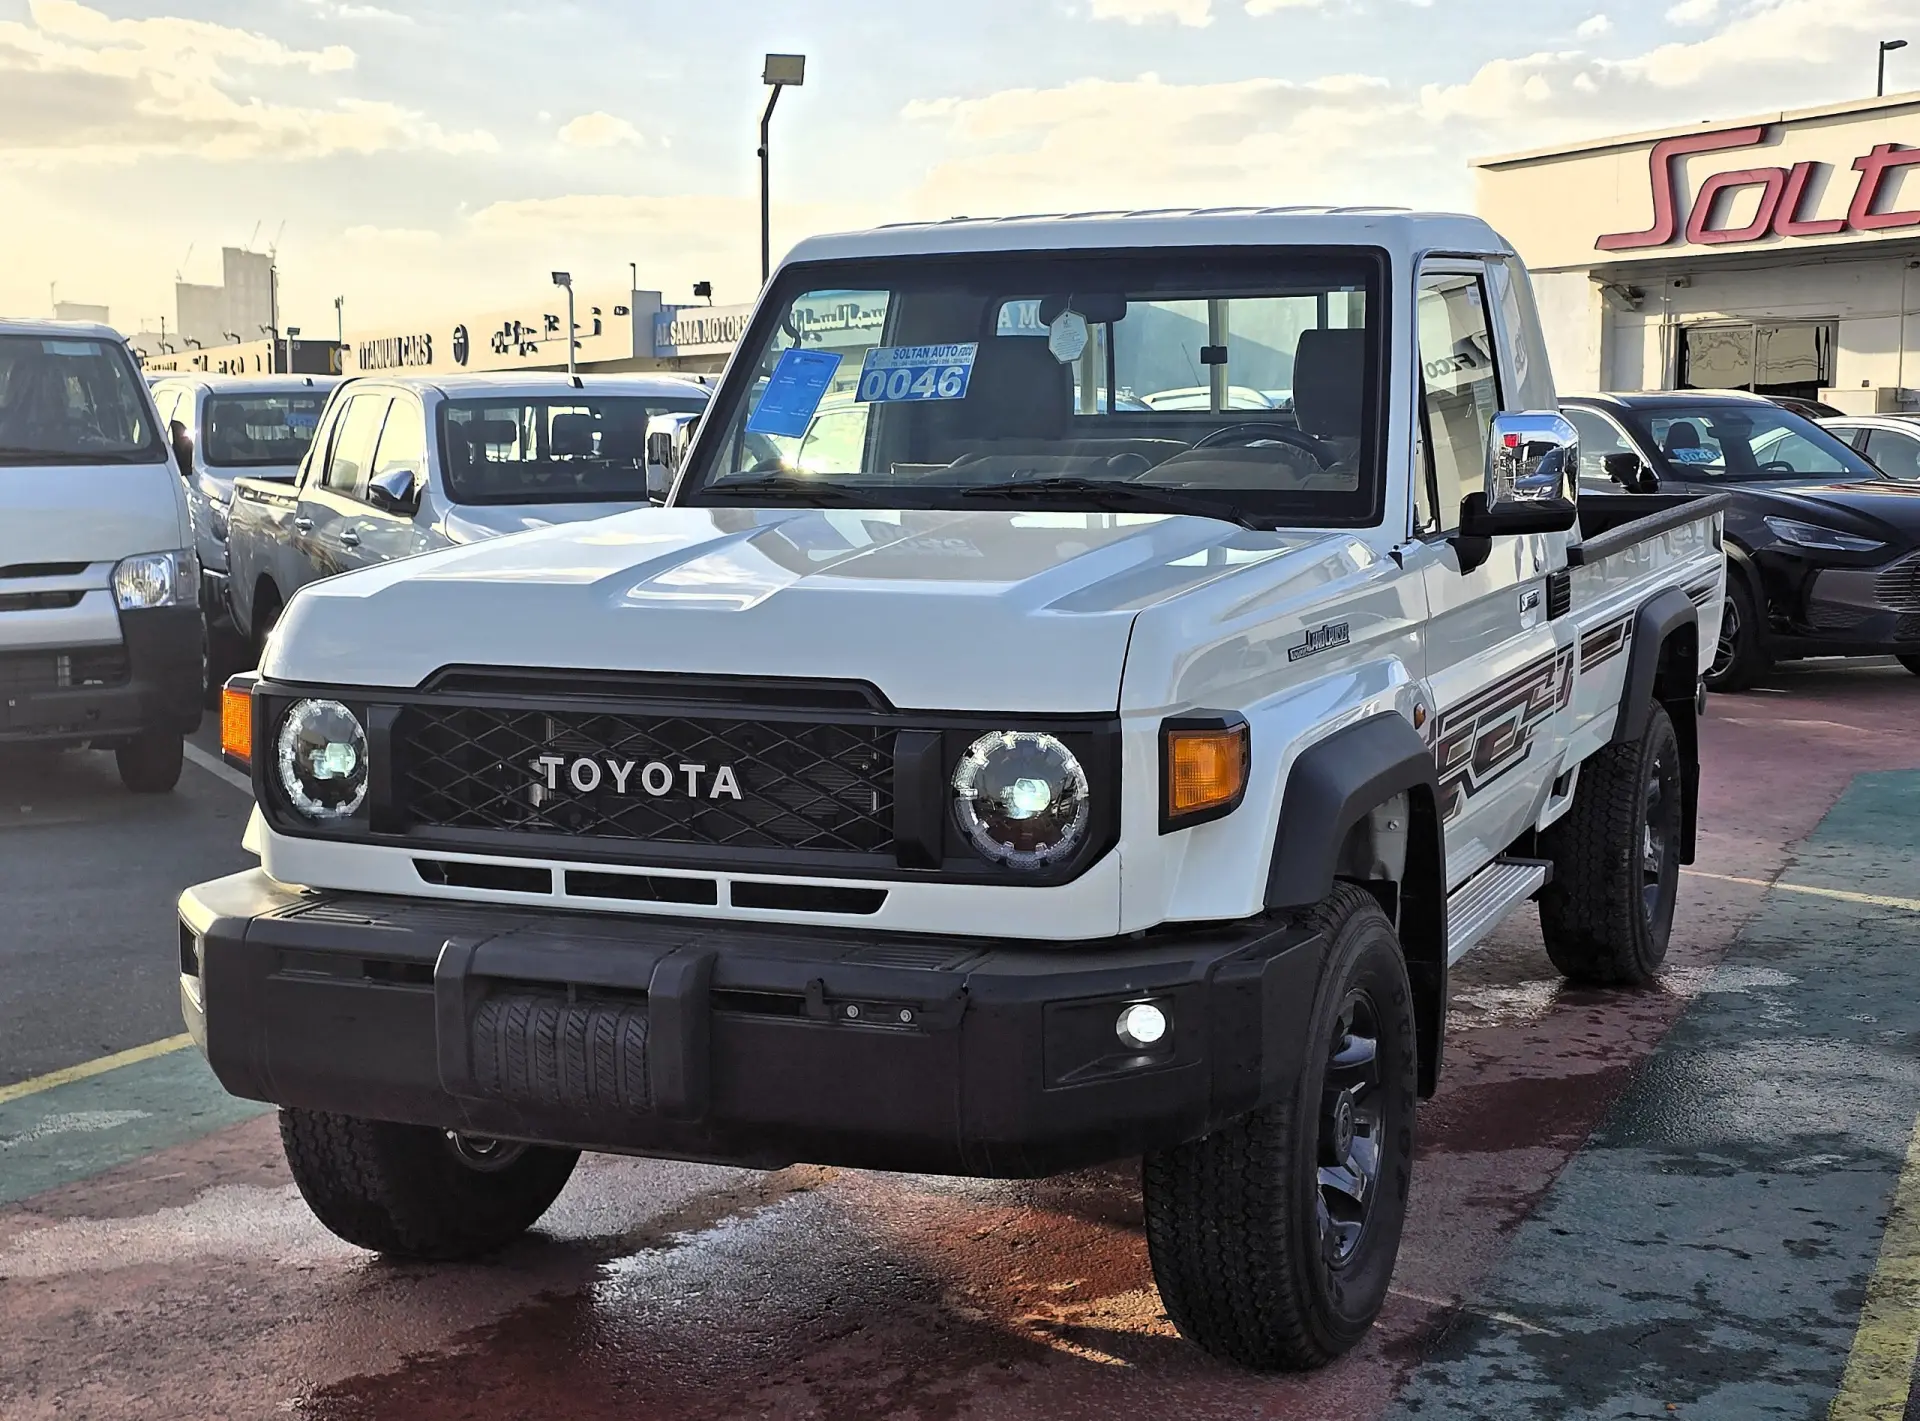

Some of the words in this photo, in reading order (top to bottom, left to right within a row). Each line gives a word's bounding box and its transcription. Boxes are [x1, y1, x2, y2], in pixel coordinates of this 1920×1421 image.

[656, 322, 669, 346] AL
[670, 319, 702, 345] SAMA
[403, 333, 433, 368] CARS
[893, 347, 931, 360] SOLTAN
[931, 345, 958, 358] AUTO
[862, 366, 964, 400] 0046
[539, 755, 743, 800] TOYOTA
